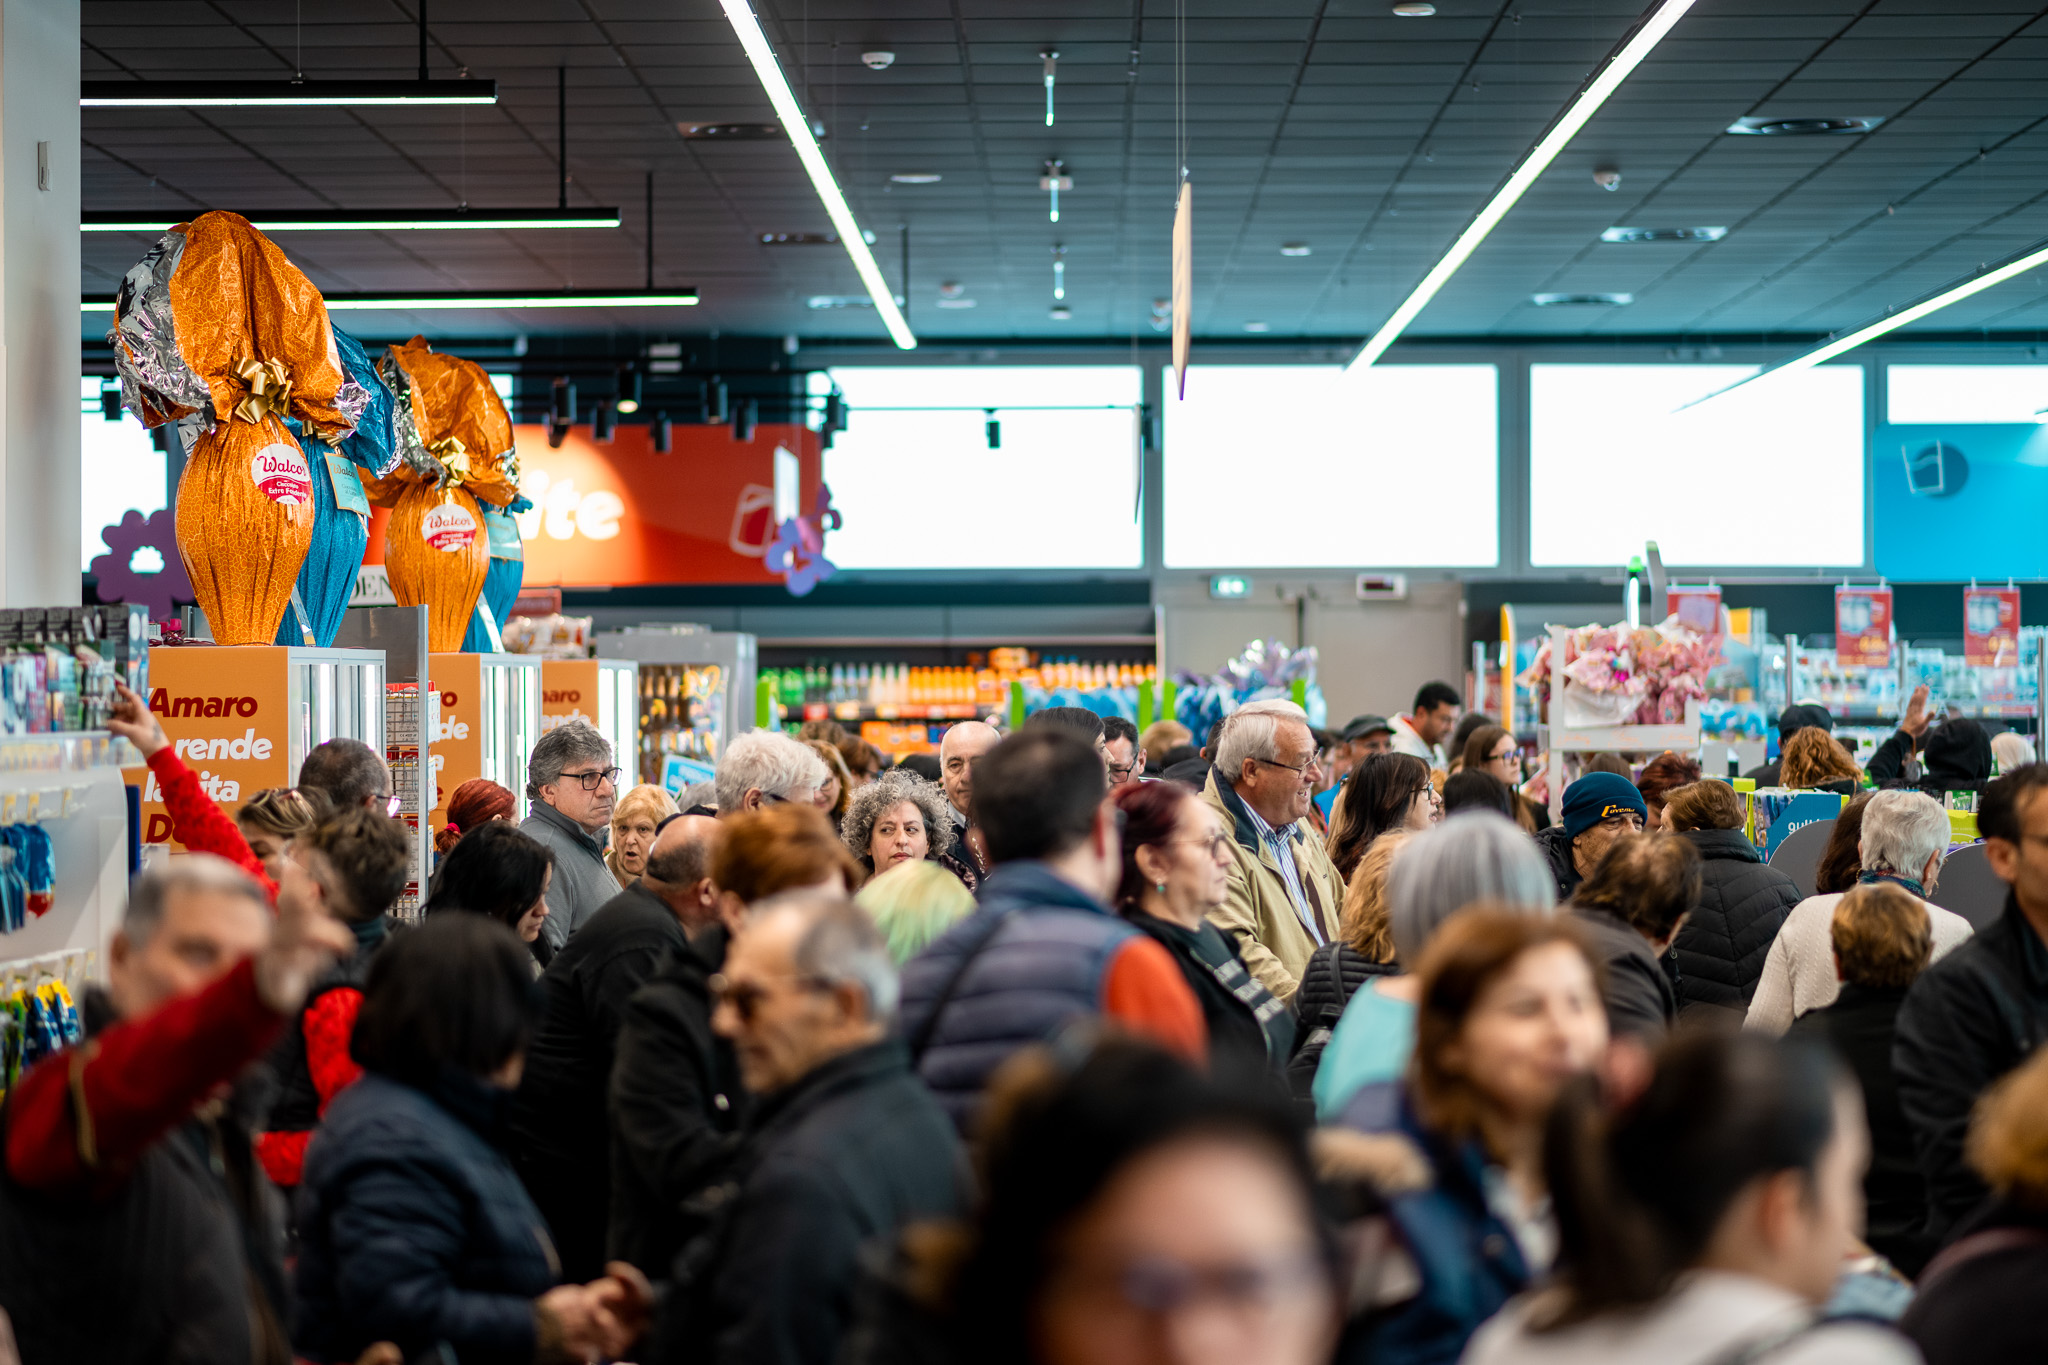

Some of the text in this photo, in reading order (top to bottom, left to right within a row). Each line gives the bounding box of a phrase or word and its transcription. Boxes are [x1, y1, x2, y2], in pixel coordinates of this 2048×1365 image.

[257, 455, 307, 477] Walcor
[427, 515, 472, 529] Walcor
[197, 770, 241, 802] ita
